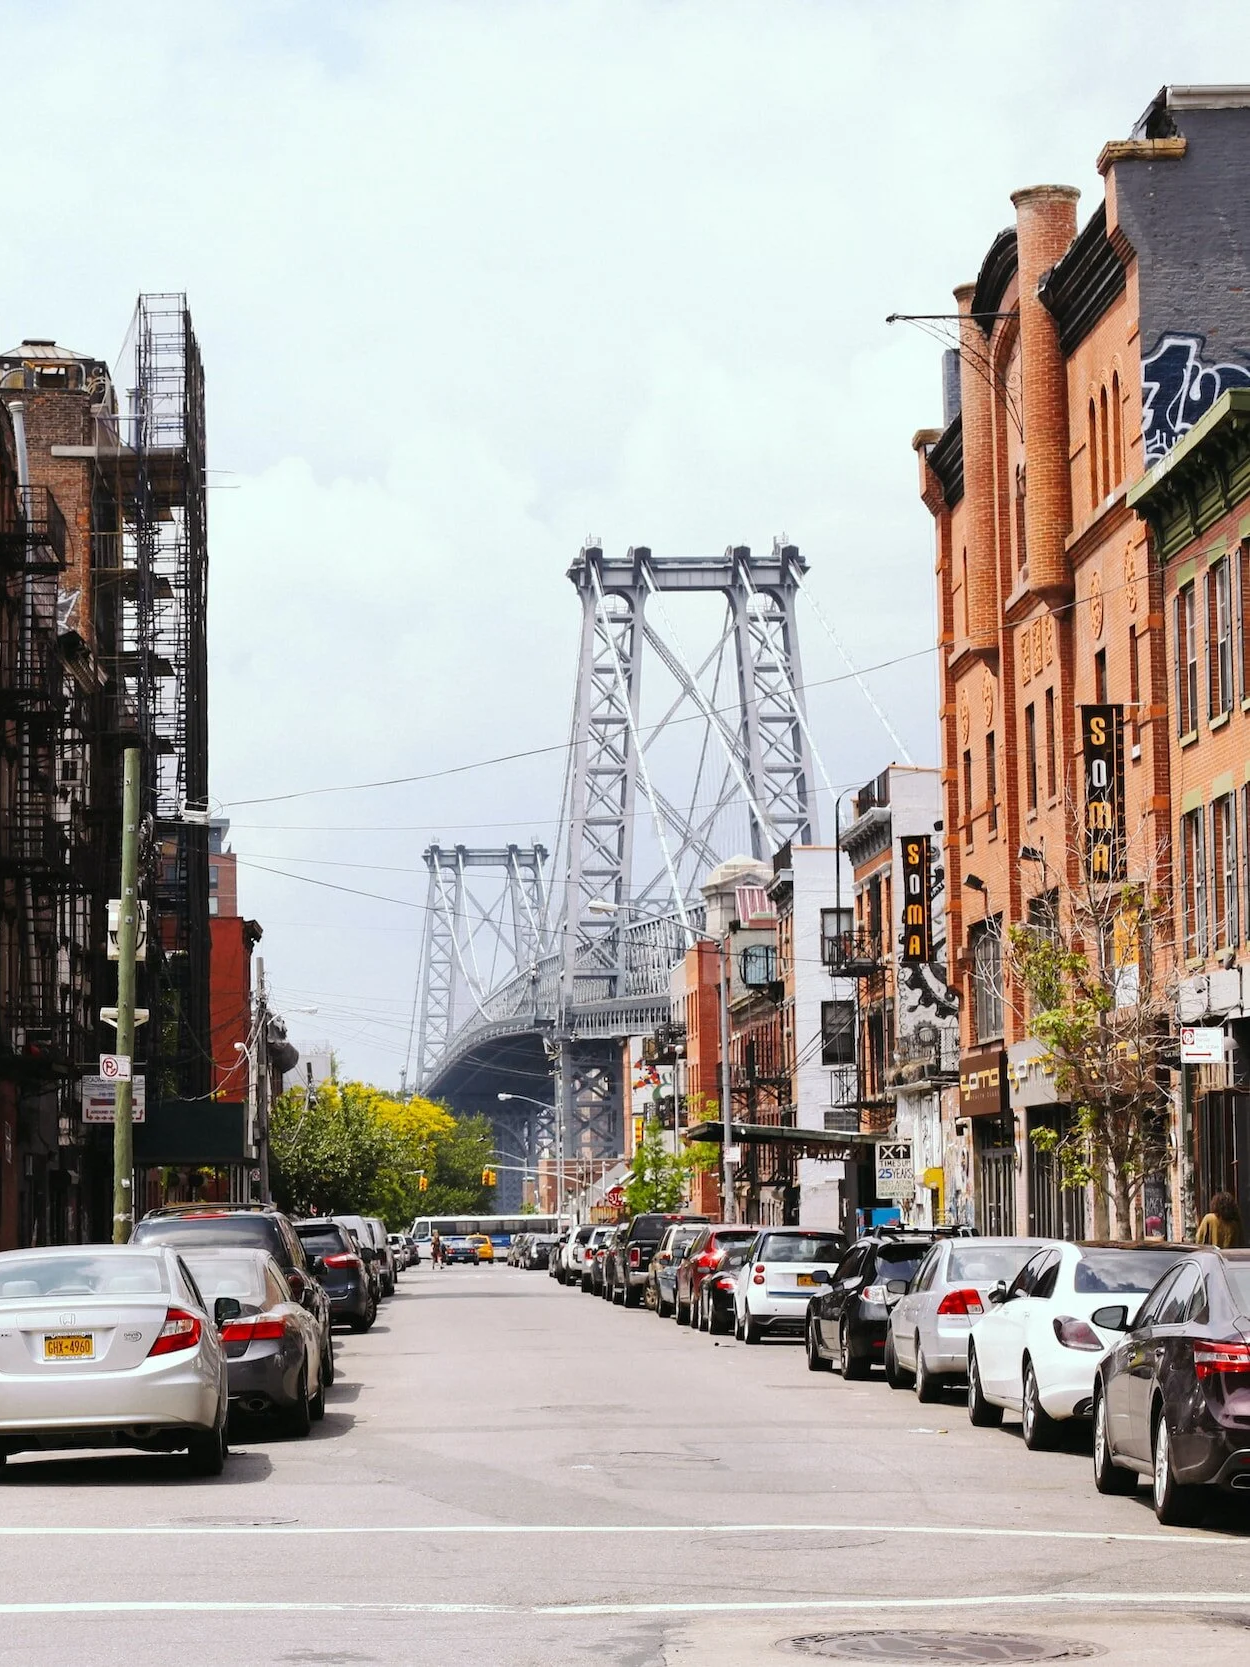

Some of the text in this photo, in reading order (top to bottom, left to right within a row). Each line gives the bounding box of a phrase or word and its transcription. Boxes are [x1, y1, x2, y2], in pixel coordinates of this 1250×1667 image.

[907, 843, 923, 956] SOMA
[878, 1168, 914, 1179] 25 YEARS
